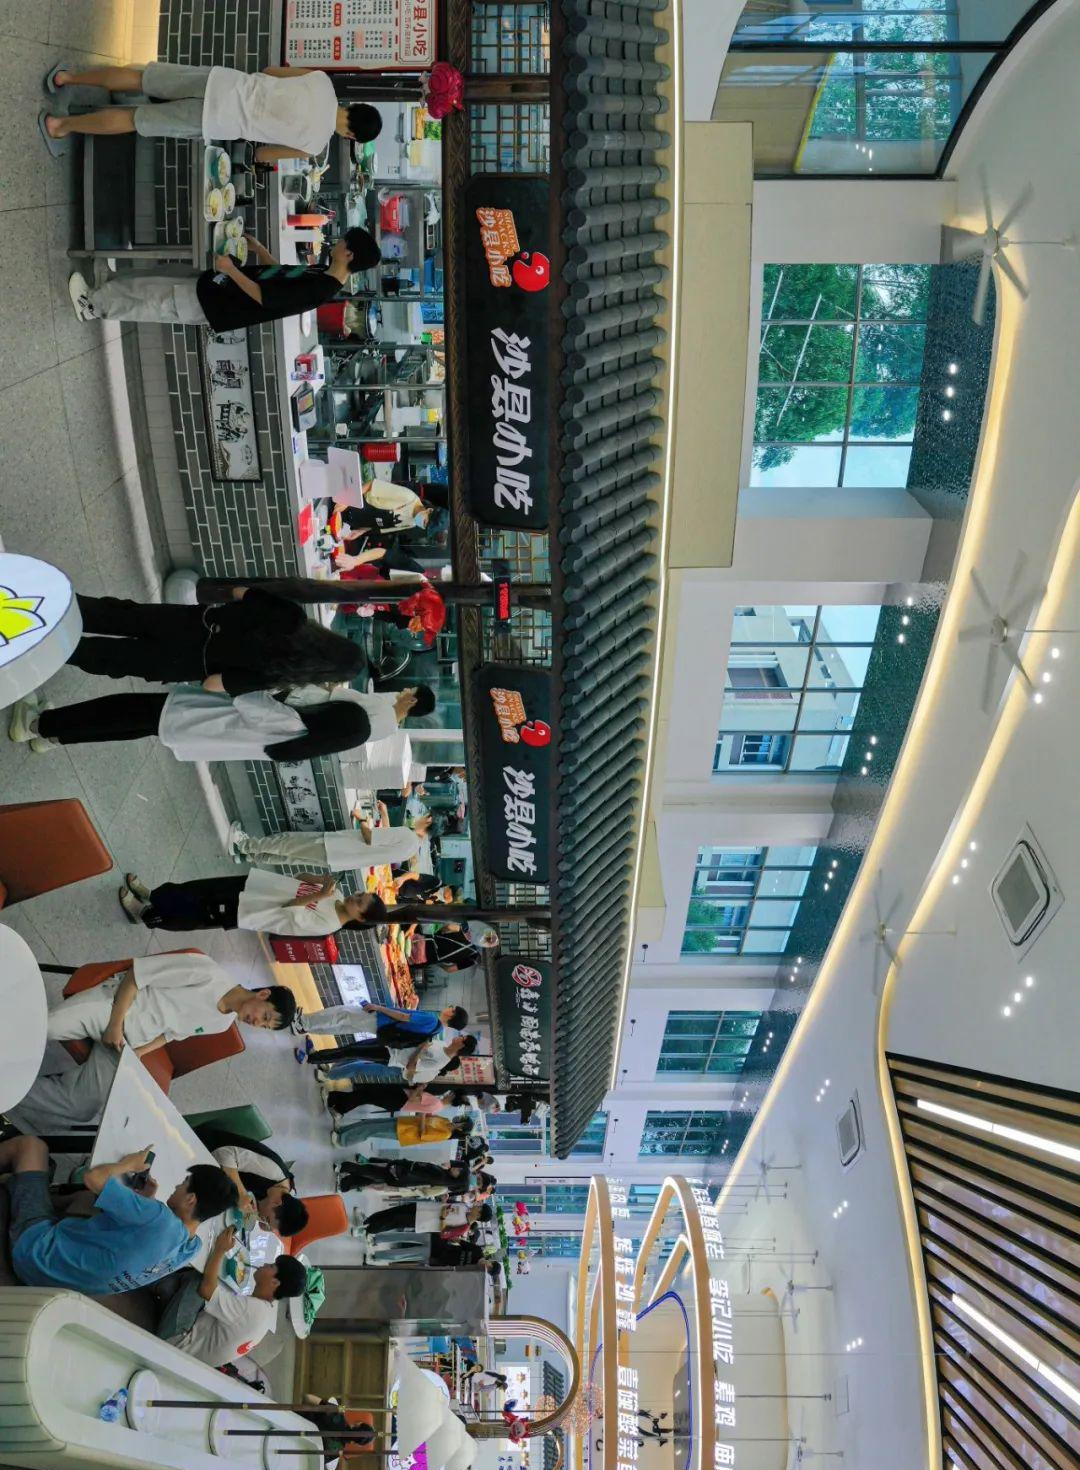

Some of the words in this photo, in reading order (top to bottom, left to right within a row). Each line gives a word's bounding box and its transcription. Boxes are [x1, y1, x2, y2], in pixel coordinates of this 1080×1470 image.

[477, 208, 511, 287] 沙县小吃
[490, 327, 533, 515] 沙县小吃
[491, 688, 519, 743] 沙县小吃
[503, 766, 537, 876] 沙县小吃
[709, 1278, 734, 1364] 李记小吃
